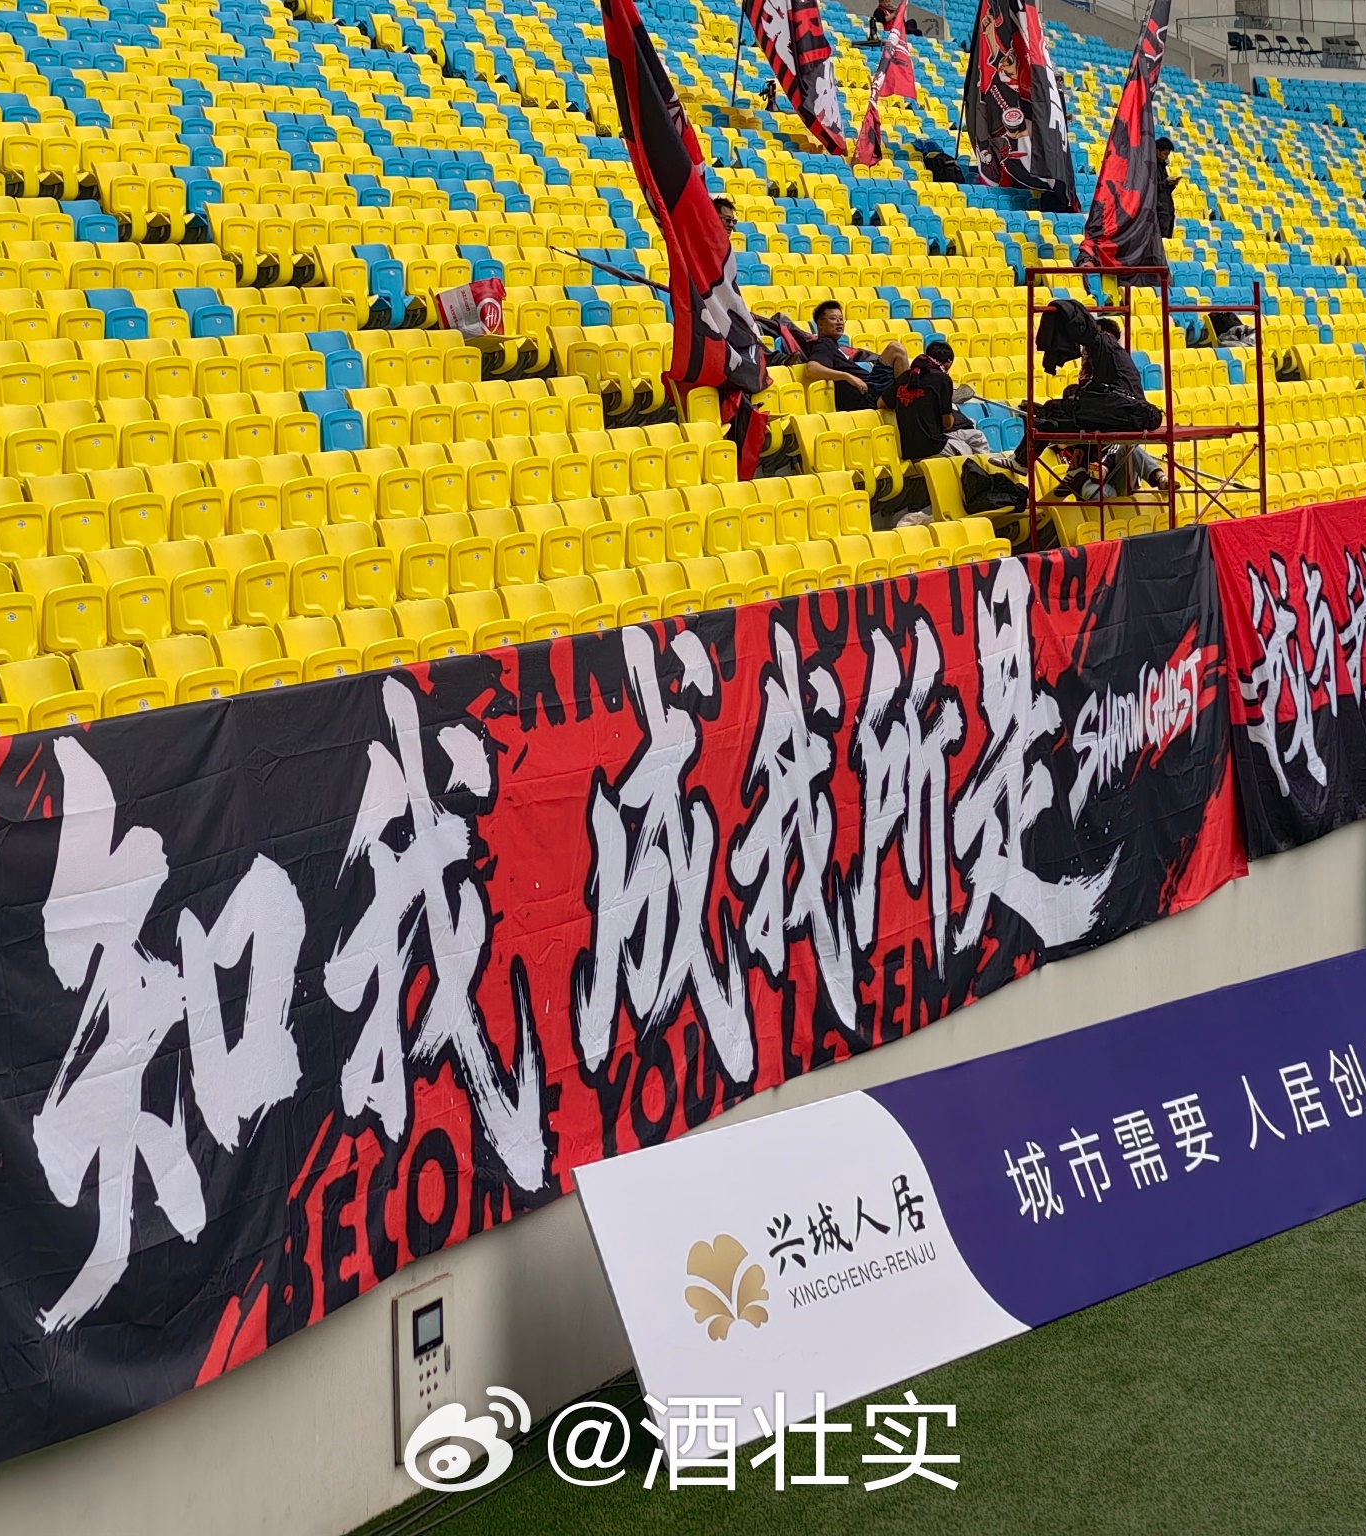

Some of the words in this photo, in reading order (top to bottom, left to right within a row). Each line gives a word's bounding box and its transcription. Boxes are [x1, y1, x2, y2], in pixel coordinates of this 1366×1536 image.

[1003, 1091, 1222, 1226] 城市需要
[767, 1173, 927, 1279] 兴城人居
[786, 1240, 938, 1310] XINGCHENG-RENJU
